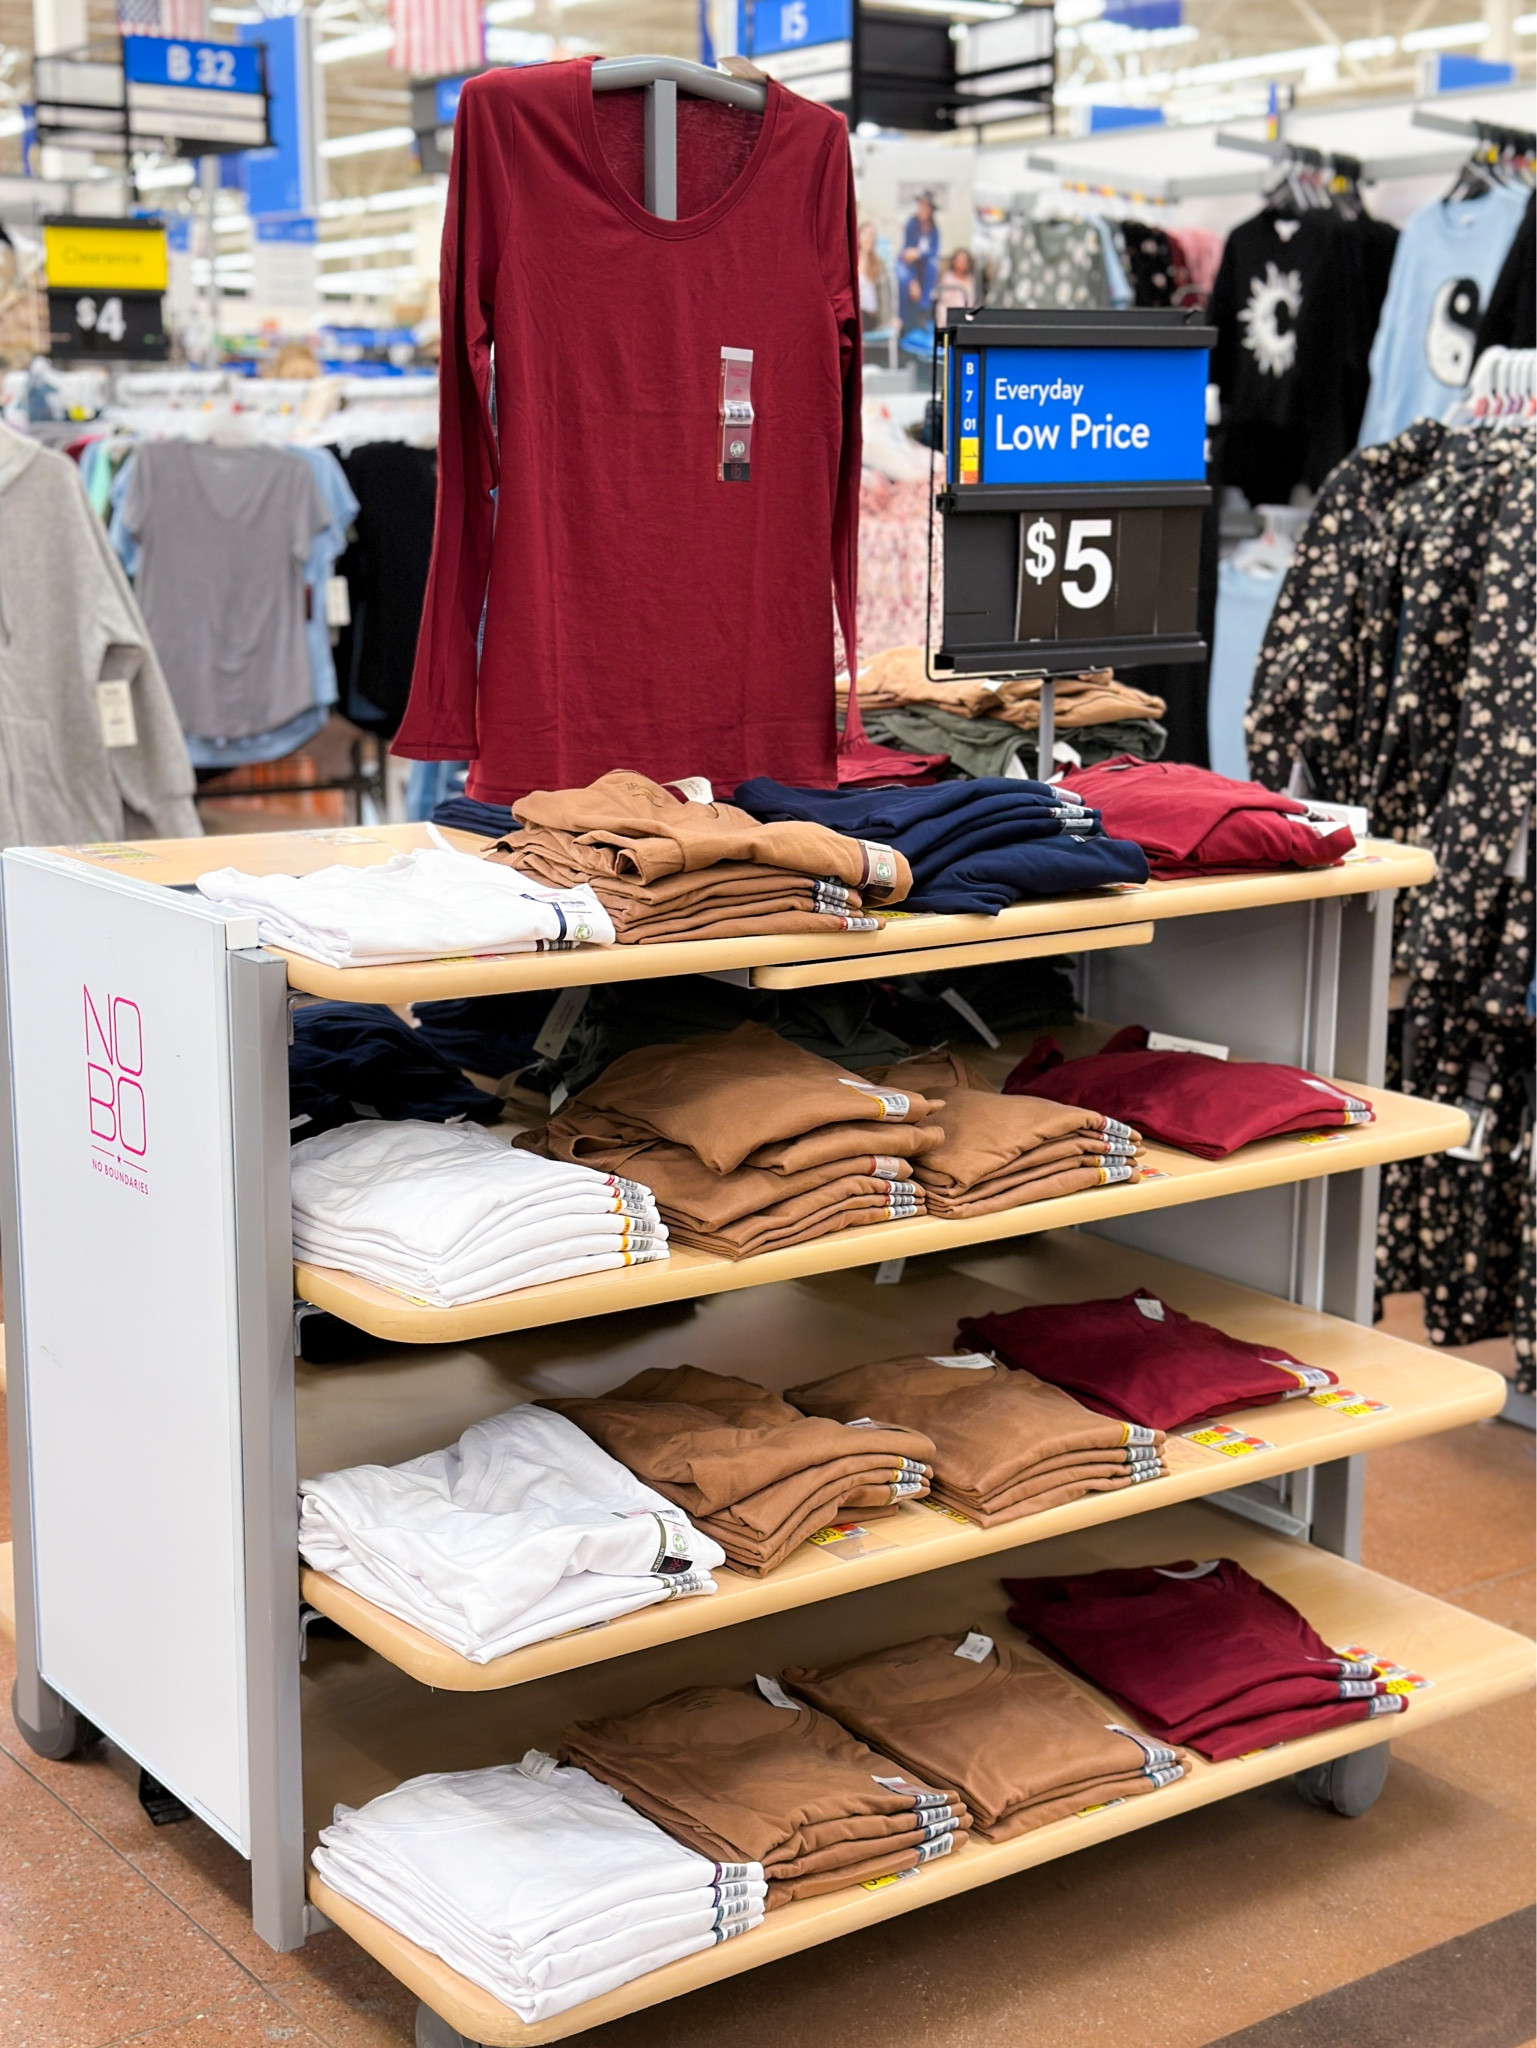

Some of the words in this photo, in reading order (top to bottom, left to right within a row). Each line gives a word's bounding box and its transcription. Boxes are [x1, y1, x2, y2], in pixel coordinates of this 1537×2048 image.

[166, 44, 192, 81] B
[195, 48, 236, 87] 32
[76, 297, 127, 341] $4
[966, 362, 975, 375] B
[966, 390, 974, 402] 7
[995, 378, 1083, 406] Everyday
[963, 418, 977, 431] 01
[996, 414, 1060, 450] Low
[1071, 413, 1150, 449] Price
[1025, 517, 1113, 609] $5
[83, 984, 142, 1076] NO
[87, 1062, 147, 1156] BO
[92, 1158, 103, 1172] NO
[104, 1164, 149, 1195] BOUNDARIES
